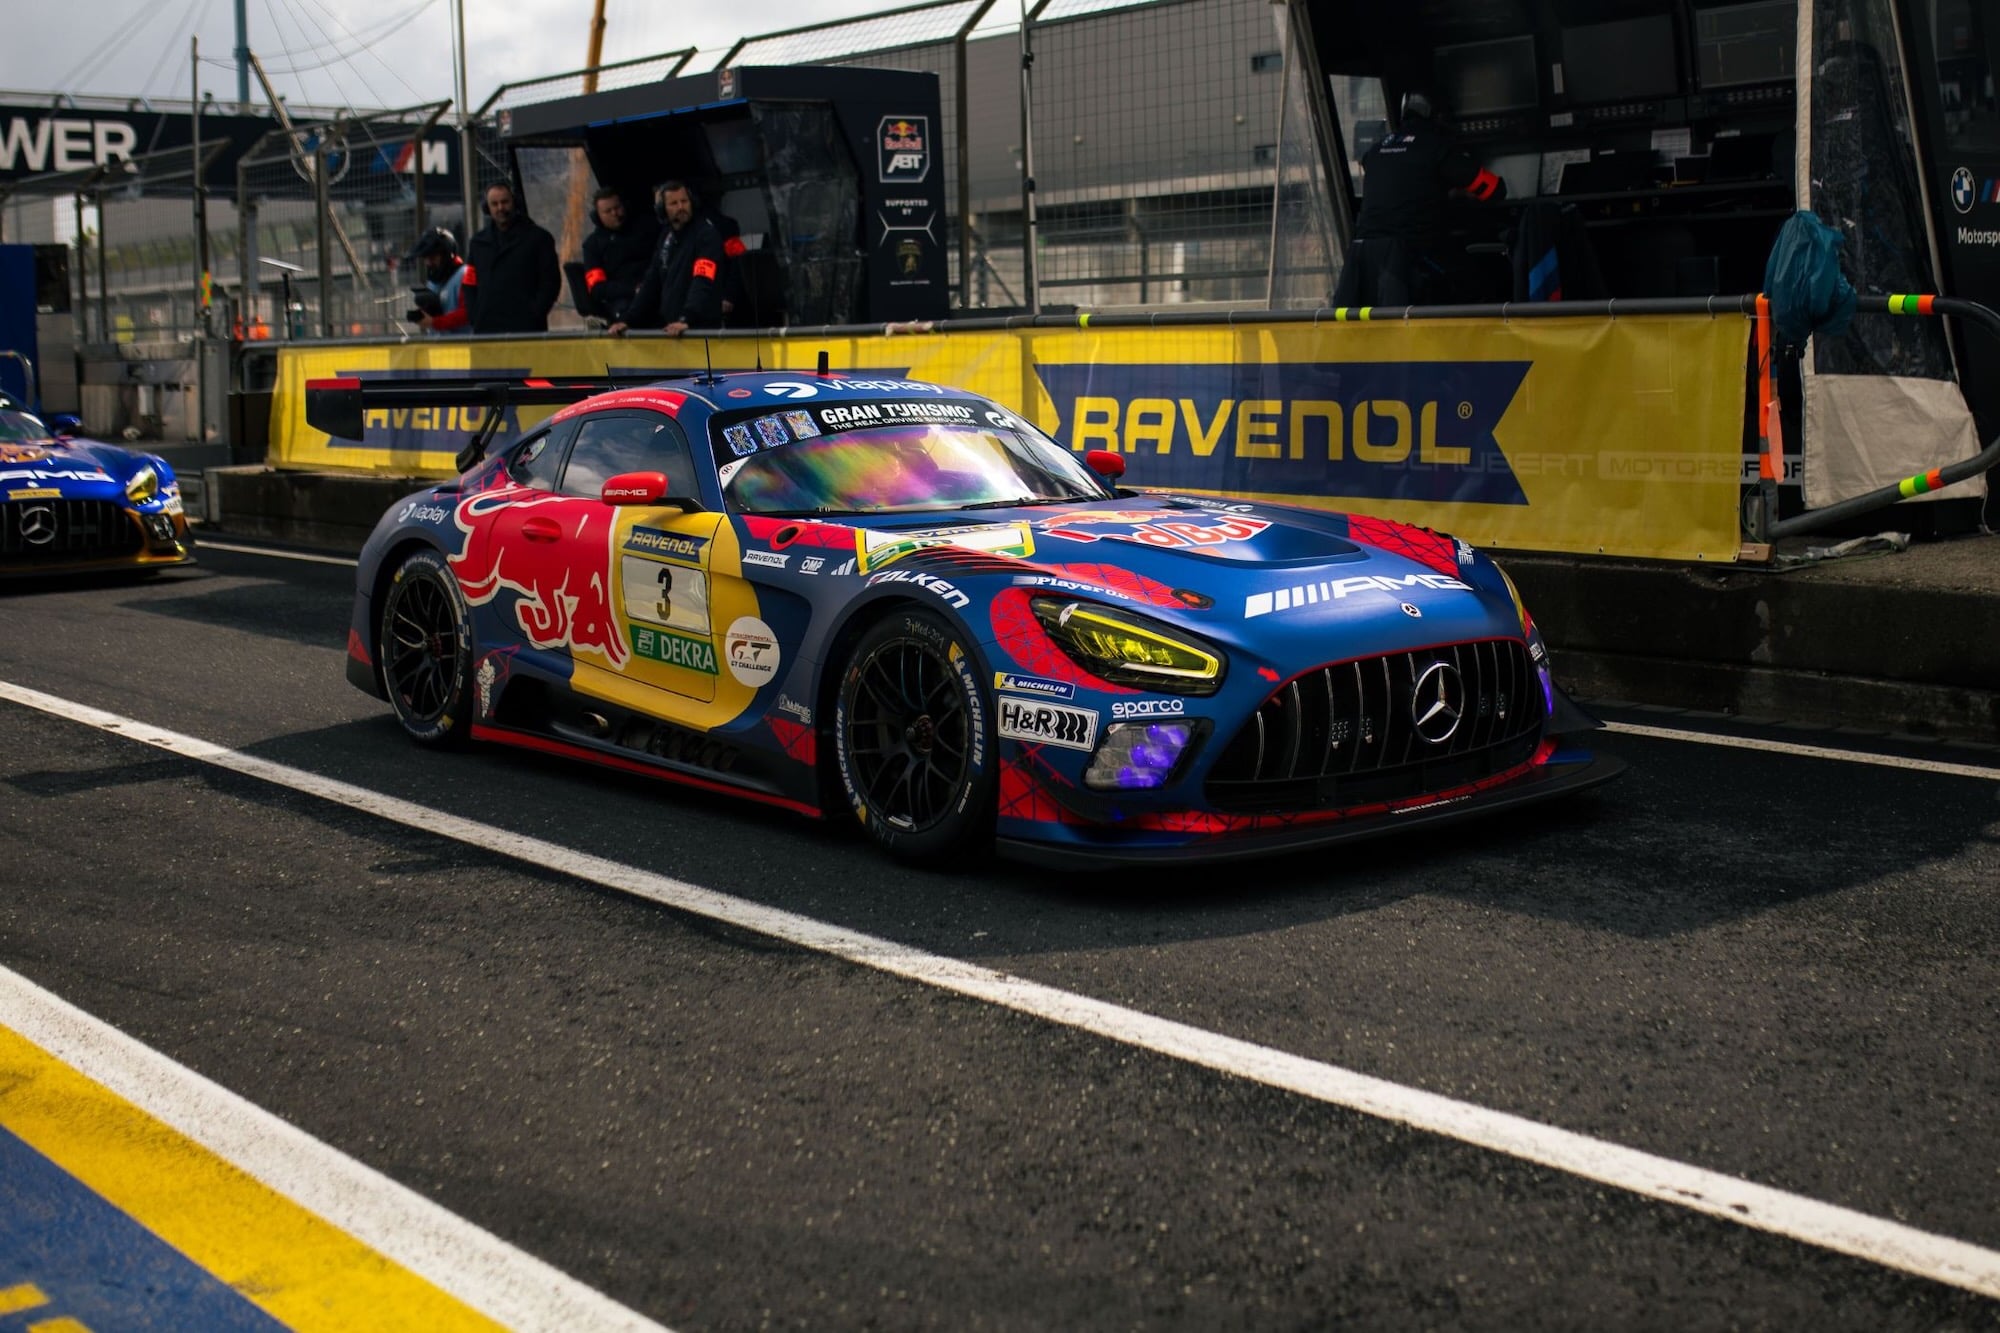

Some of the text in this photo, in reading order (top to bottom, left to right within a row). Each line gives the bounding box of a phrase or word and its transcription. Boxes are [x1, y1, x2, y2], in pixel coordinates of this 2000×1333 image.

[887, 153, 923, 173] ABT
[885, 199, 929, 208] SUPPORTED
[820, 404, 882, 424] GRAN
[830, 422, 854, 431] THE
[854, 419, 883, 428] REAL
[883, 416, 923, 424] DRIVING
[613, 489, 648, 497] AMG
[632, 532, 696, 555] RAVENOL
[747, 553, 783, 565] RAVENOL
[801, 559, 824, 571] OMP
[656, 567, 673, 621] 3
[864, 570, 970, 608] FALKEN
[1331, 574, 1474, 599] AMG
[660, 634, 717, 673] DEKRA
[738, 661, 772, 672] CHALLENGE
[1017, 680, 1067, 693] MICHELIN
[1111, 699, 1184, 719] sparco
[962, 673, 984, 766] MICHELIN
[1002, 702, 1055, 737] H&R
